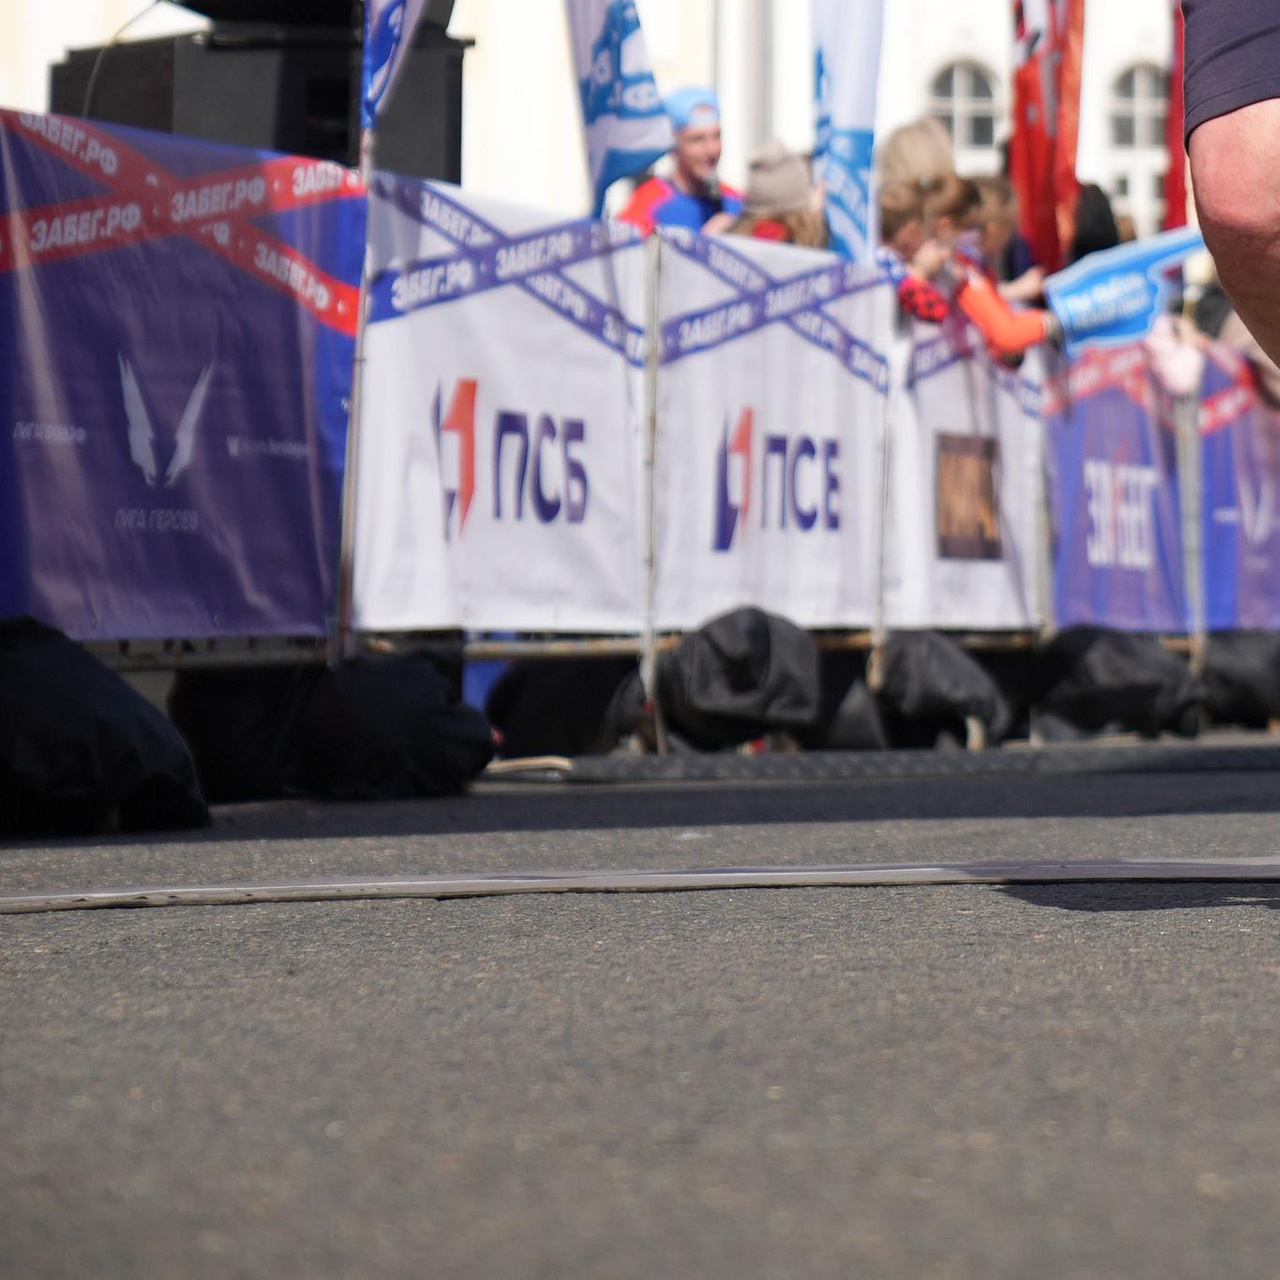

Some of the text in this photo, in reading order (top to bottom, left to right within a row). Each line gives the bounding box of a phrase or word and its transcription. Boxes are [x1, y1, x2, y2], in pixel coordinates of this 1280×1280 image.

[30, 203, 142, 251] ЗАБЕГ.РФ
[170, 175, 267, 222] ЗАБЕГ.РФ
[493, 410, 590, 525] ПСБ
